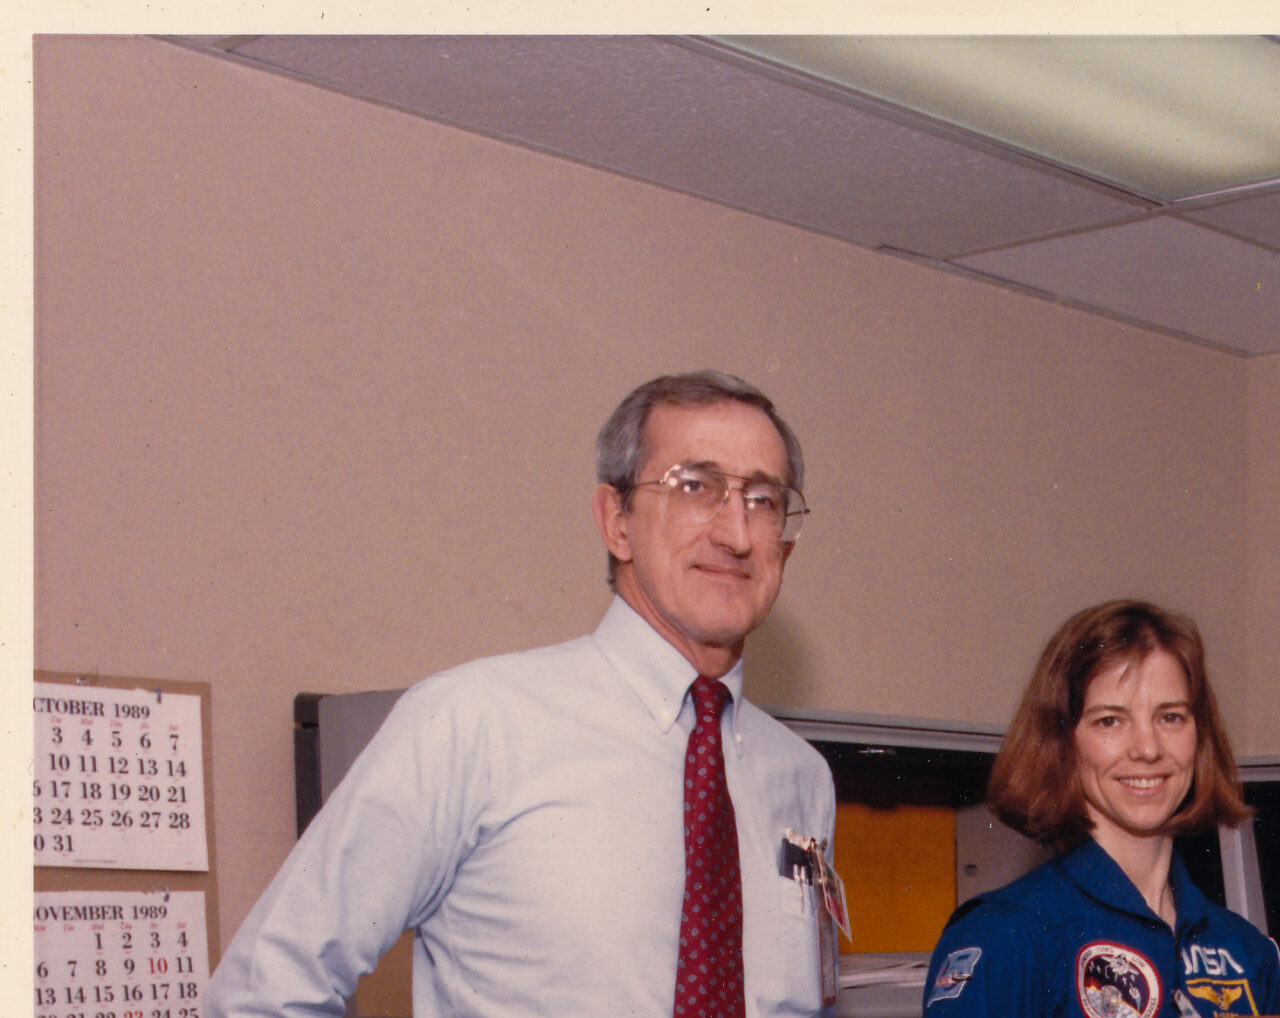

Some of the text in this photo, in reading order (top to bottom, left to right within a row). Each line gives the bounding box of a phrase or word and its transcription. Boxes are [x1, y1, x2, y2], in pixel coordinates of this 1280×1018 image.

[115, 703, 150, 719] 1989
[52, 727, 179, 751] 3 4 5 6 7
[49, 754, 187, 777] 10 11 12 13 14
[51, 781, 70, 798] 17
[82, 782, 102, 799] 18
[111, 784, 131, 800] 19
[139, 785, 160, 801] 20
[168, 786, 186, 803] 21
[52, 808, 74, 825] 24
[82, 809, 103, 826] 25
[111, 810, 133, 827] 26
[140, 812, 161, 828] 27
[169, 813, 190, 829] 28
[54, 835, 73, 852] 31
[33, 905, 167, 921] OVEMBER 1989
[96, 931, 188, 950] 1 2 3 4
[37, 957, 194, 978] 6 7 8 9 10 11
[36, 982, 198, 1006] 13 14 15 16 17 18
